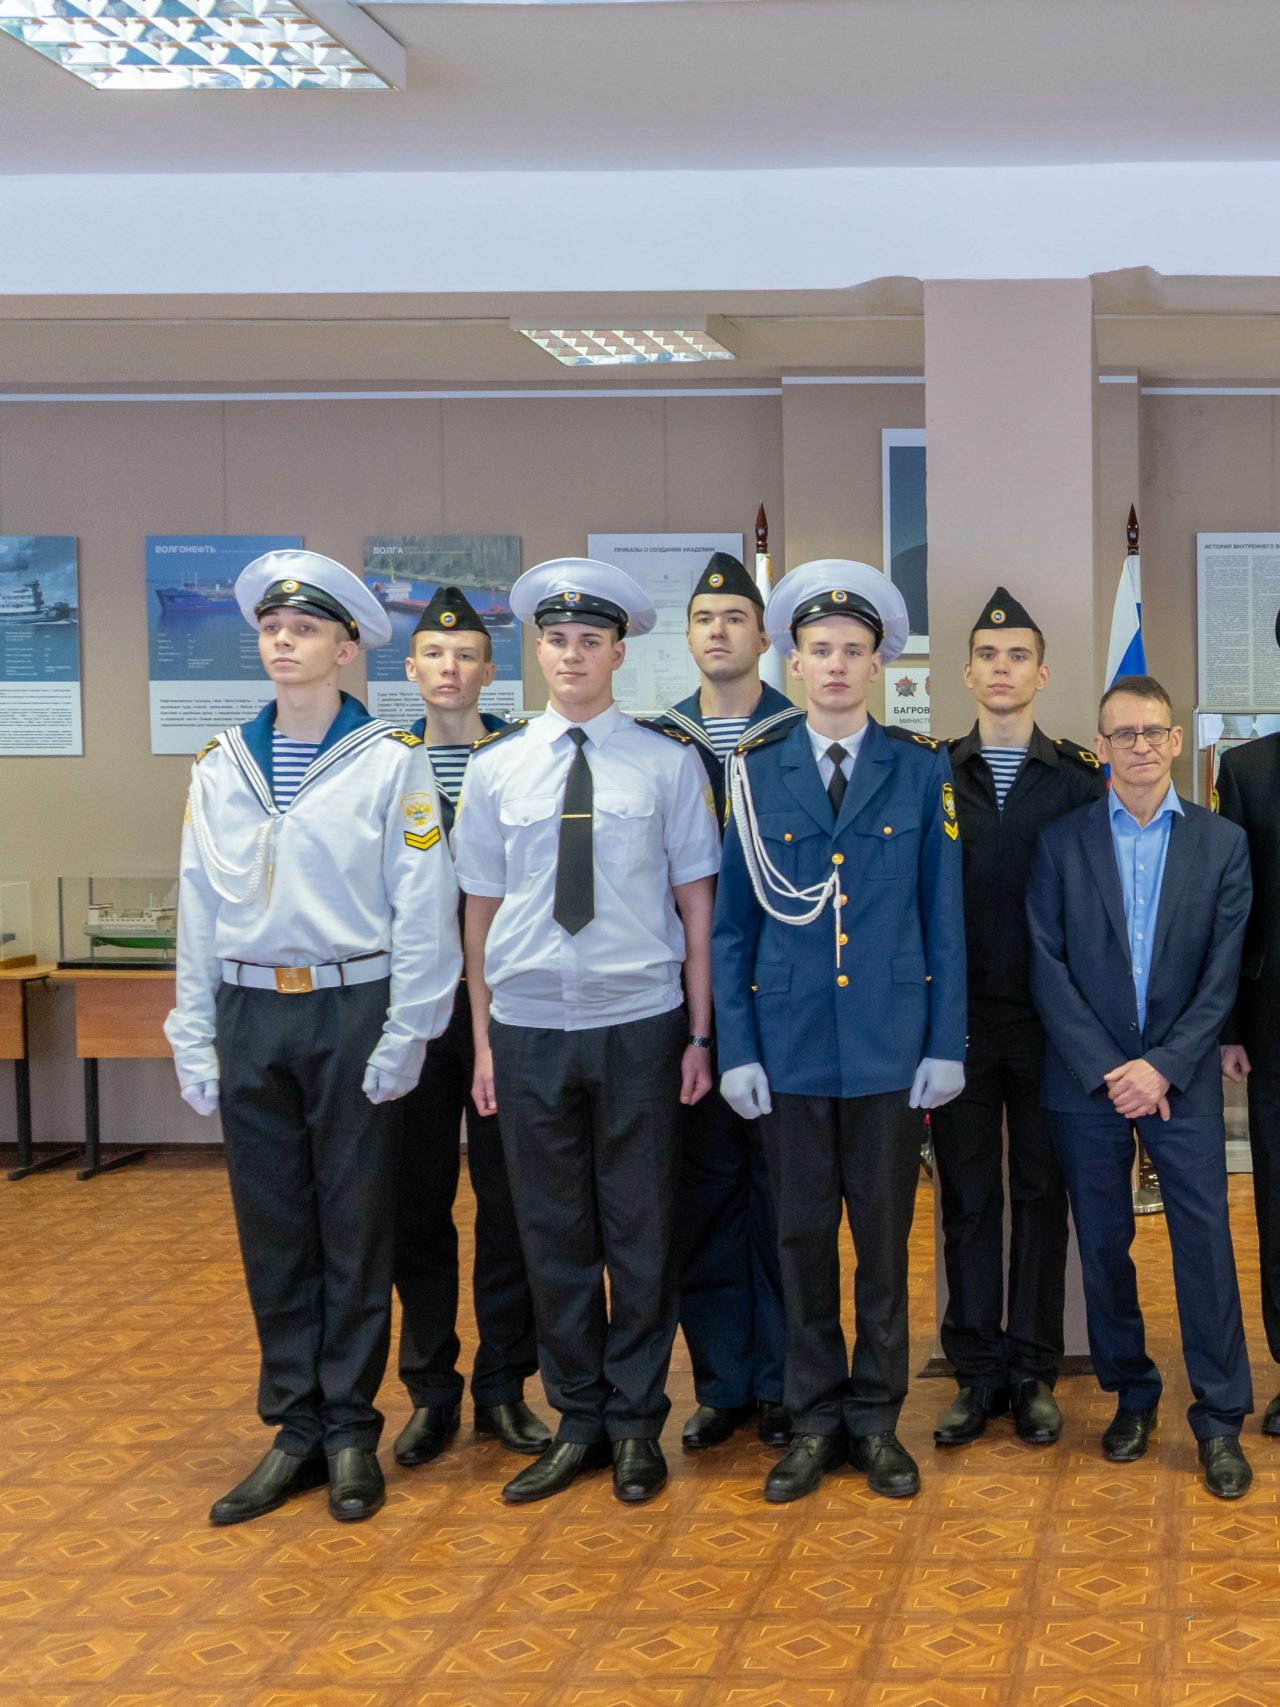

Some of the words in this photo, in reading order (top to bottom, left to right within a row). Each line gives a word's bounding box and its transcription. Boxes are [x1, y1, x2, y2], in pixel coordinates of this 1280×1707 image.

[155, 545, 216, 554] ВОЛГОНЕФТЬ
[373, 546, 404, 555] ВОЛГА
[650, 546, 682, 554] СОЗДАНИИ
[893, 706, 930, 714] БАГРОВ
